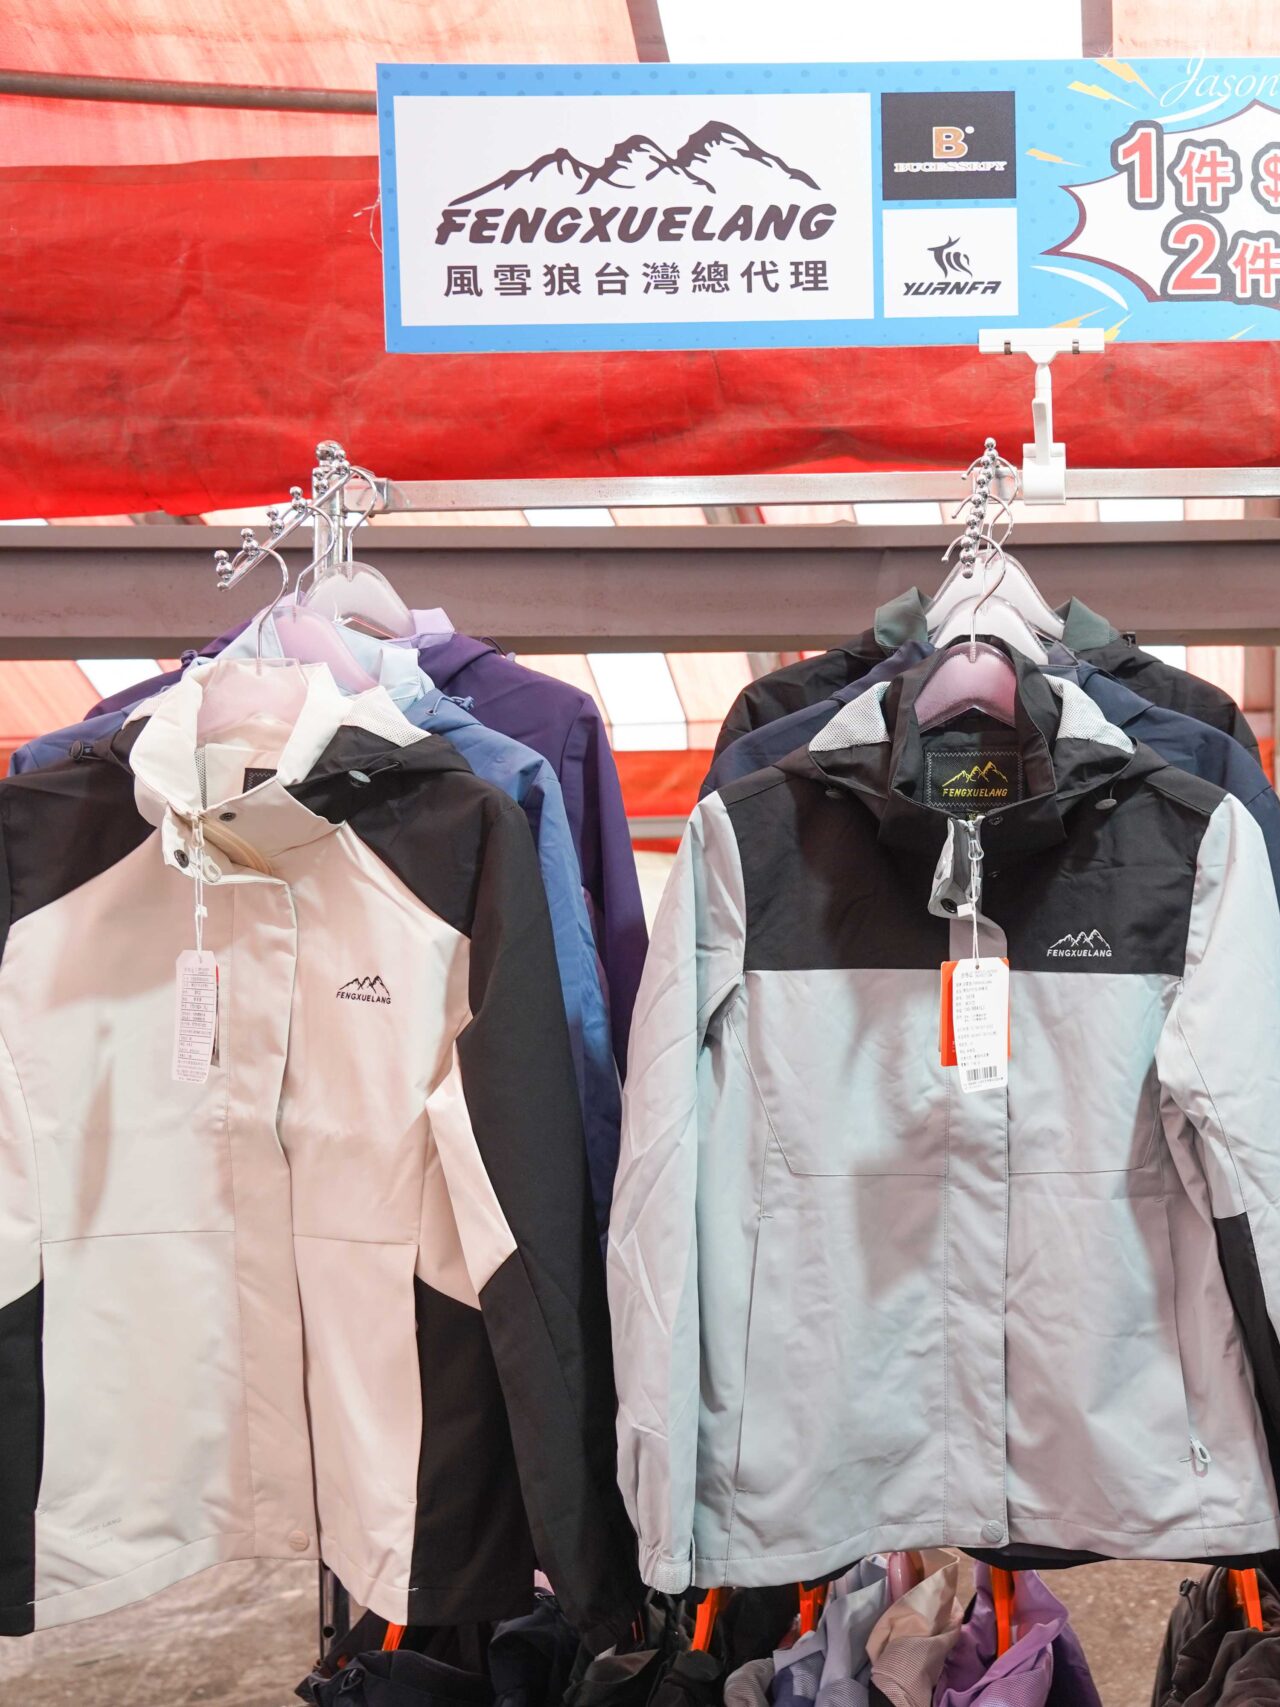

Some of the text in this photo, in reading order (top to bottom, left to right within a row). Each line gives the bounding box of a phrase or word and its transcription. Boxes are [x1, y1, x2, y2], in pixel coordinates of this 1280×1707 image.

[434, 203, 837, 245] FENGXUELANG
[443, 259, 830, 299] 風雪狼台灣總代理
[902, 280, 1002, 296] YUANFA
[942, 787, 1008, 798] FENGXUELANG
[1046, 948, 1112, 958] FENGXUELANG
[335, 991, 392, 1005] FENGXUELANG
